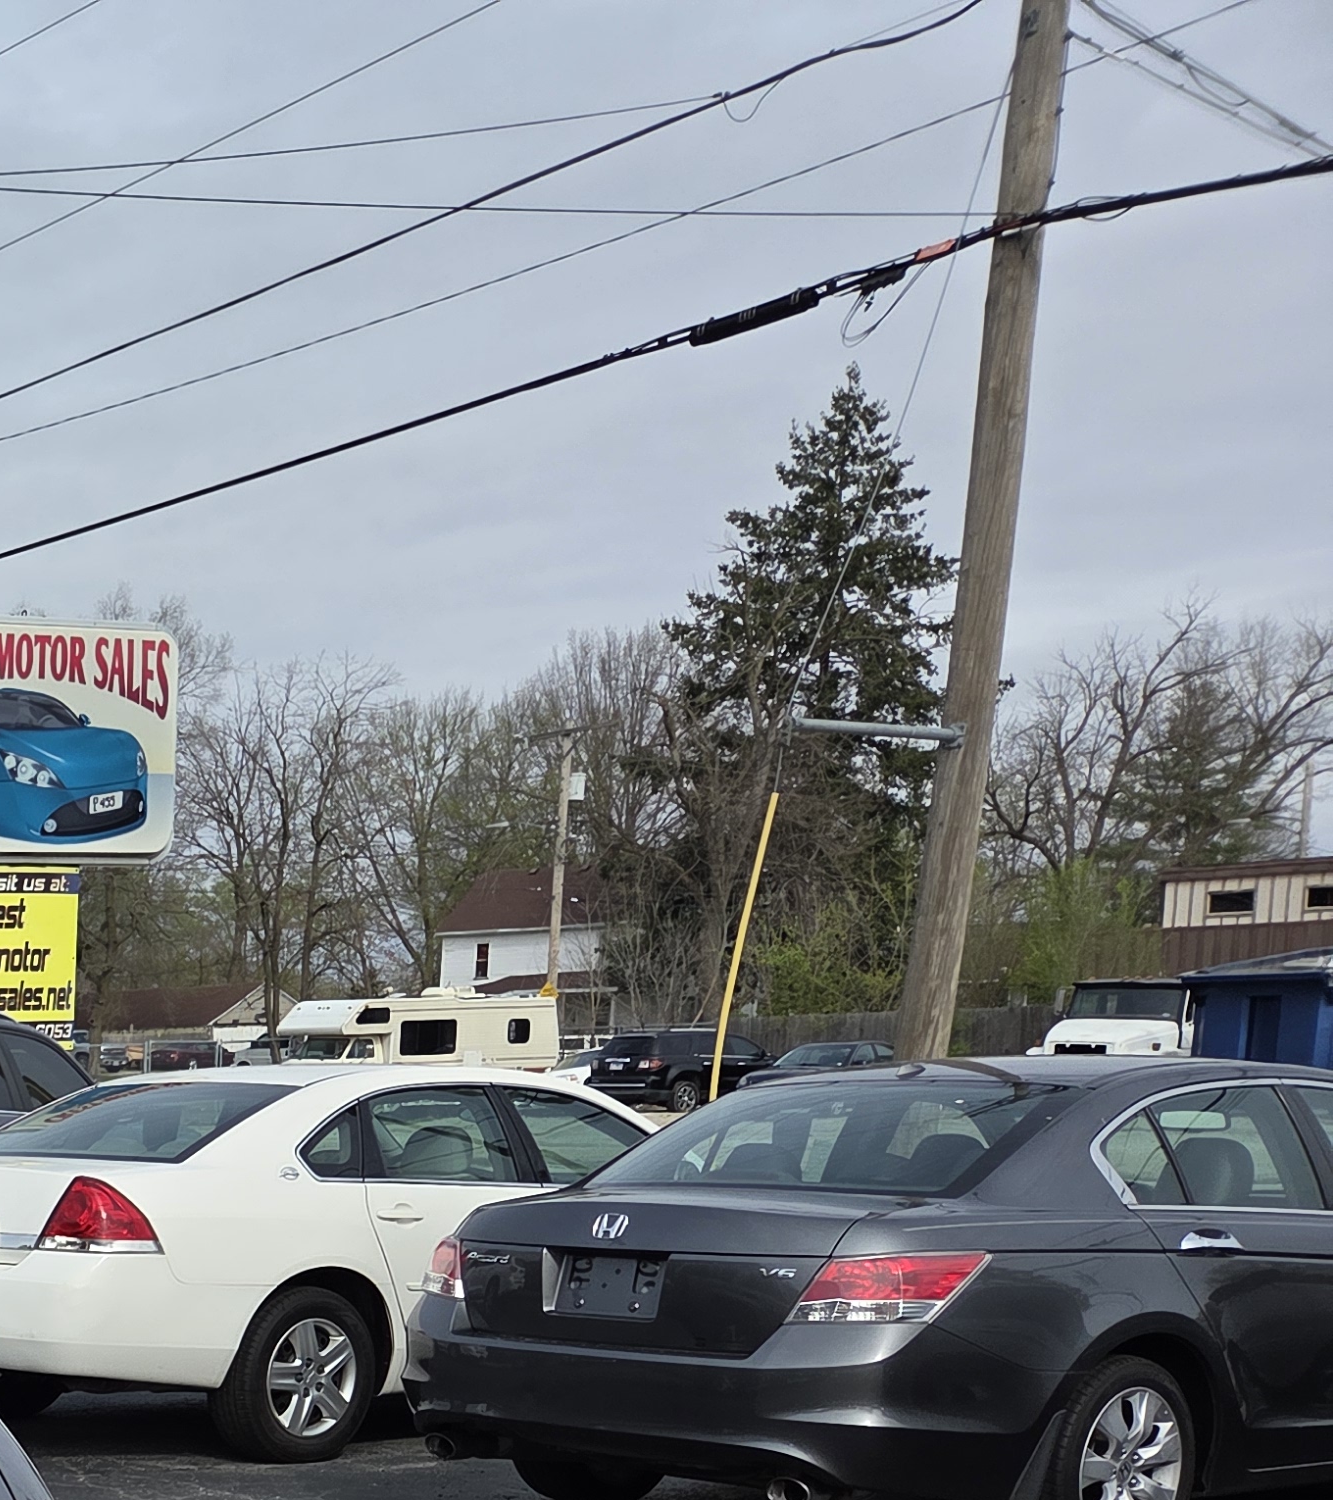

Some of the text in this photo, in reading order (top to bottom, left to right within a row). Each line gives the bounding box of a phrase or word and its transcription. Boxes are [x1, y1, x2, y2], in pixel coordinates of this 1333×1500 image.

[93, 636, 170, 720] SALES
[22, 878, 46, 891] us
[49, 875, 70, 891] at:
[466, 1251, 510, 1263] Accord
[759, 1268, 797, 1278] V6
